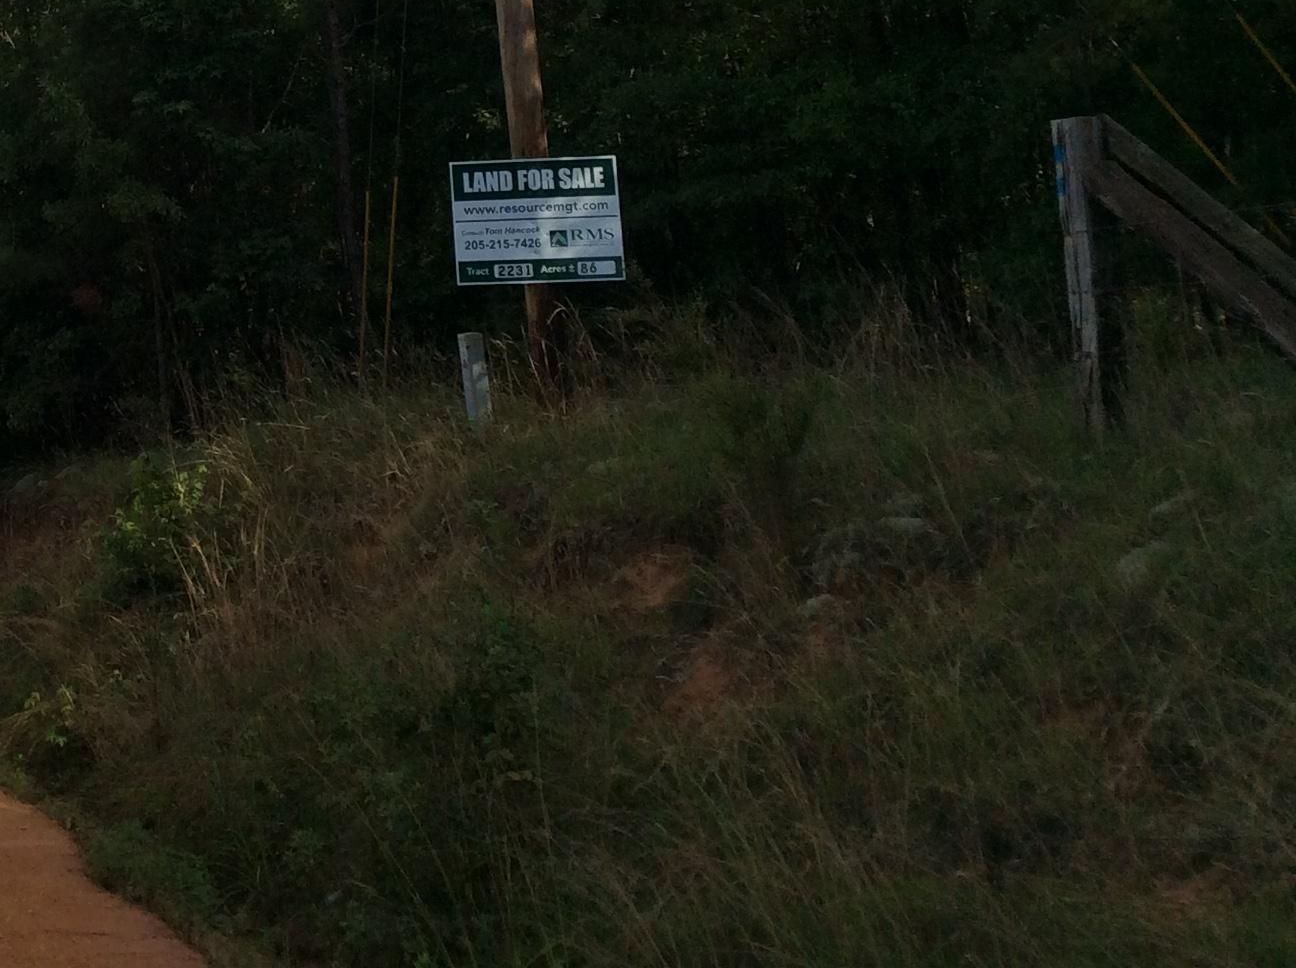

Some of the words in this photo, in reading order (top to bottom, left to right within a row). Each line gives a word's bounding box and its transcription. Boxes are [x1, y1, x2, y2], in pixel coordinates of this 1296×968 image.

[462, 170, 513, 193] LAND
[517, 168, 554, 191] FOR
[558, 166, 605, 189] SALE
[463, 200, 609, 216] www.resourcemgt.com
[570, 228, 615, 241] RMS
[464, 238, 542, 251] 205-215-7426
[466, 266, 490, 276] Tract
[498, 264, 532, 277] 2231
[539, 264, 567, 274] Acres
[580, 263, 598, 274] 86
